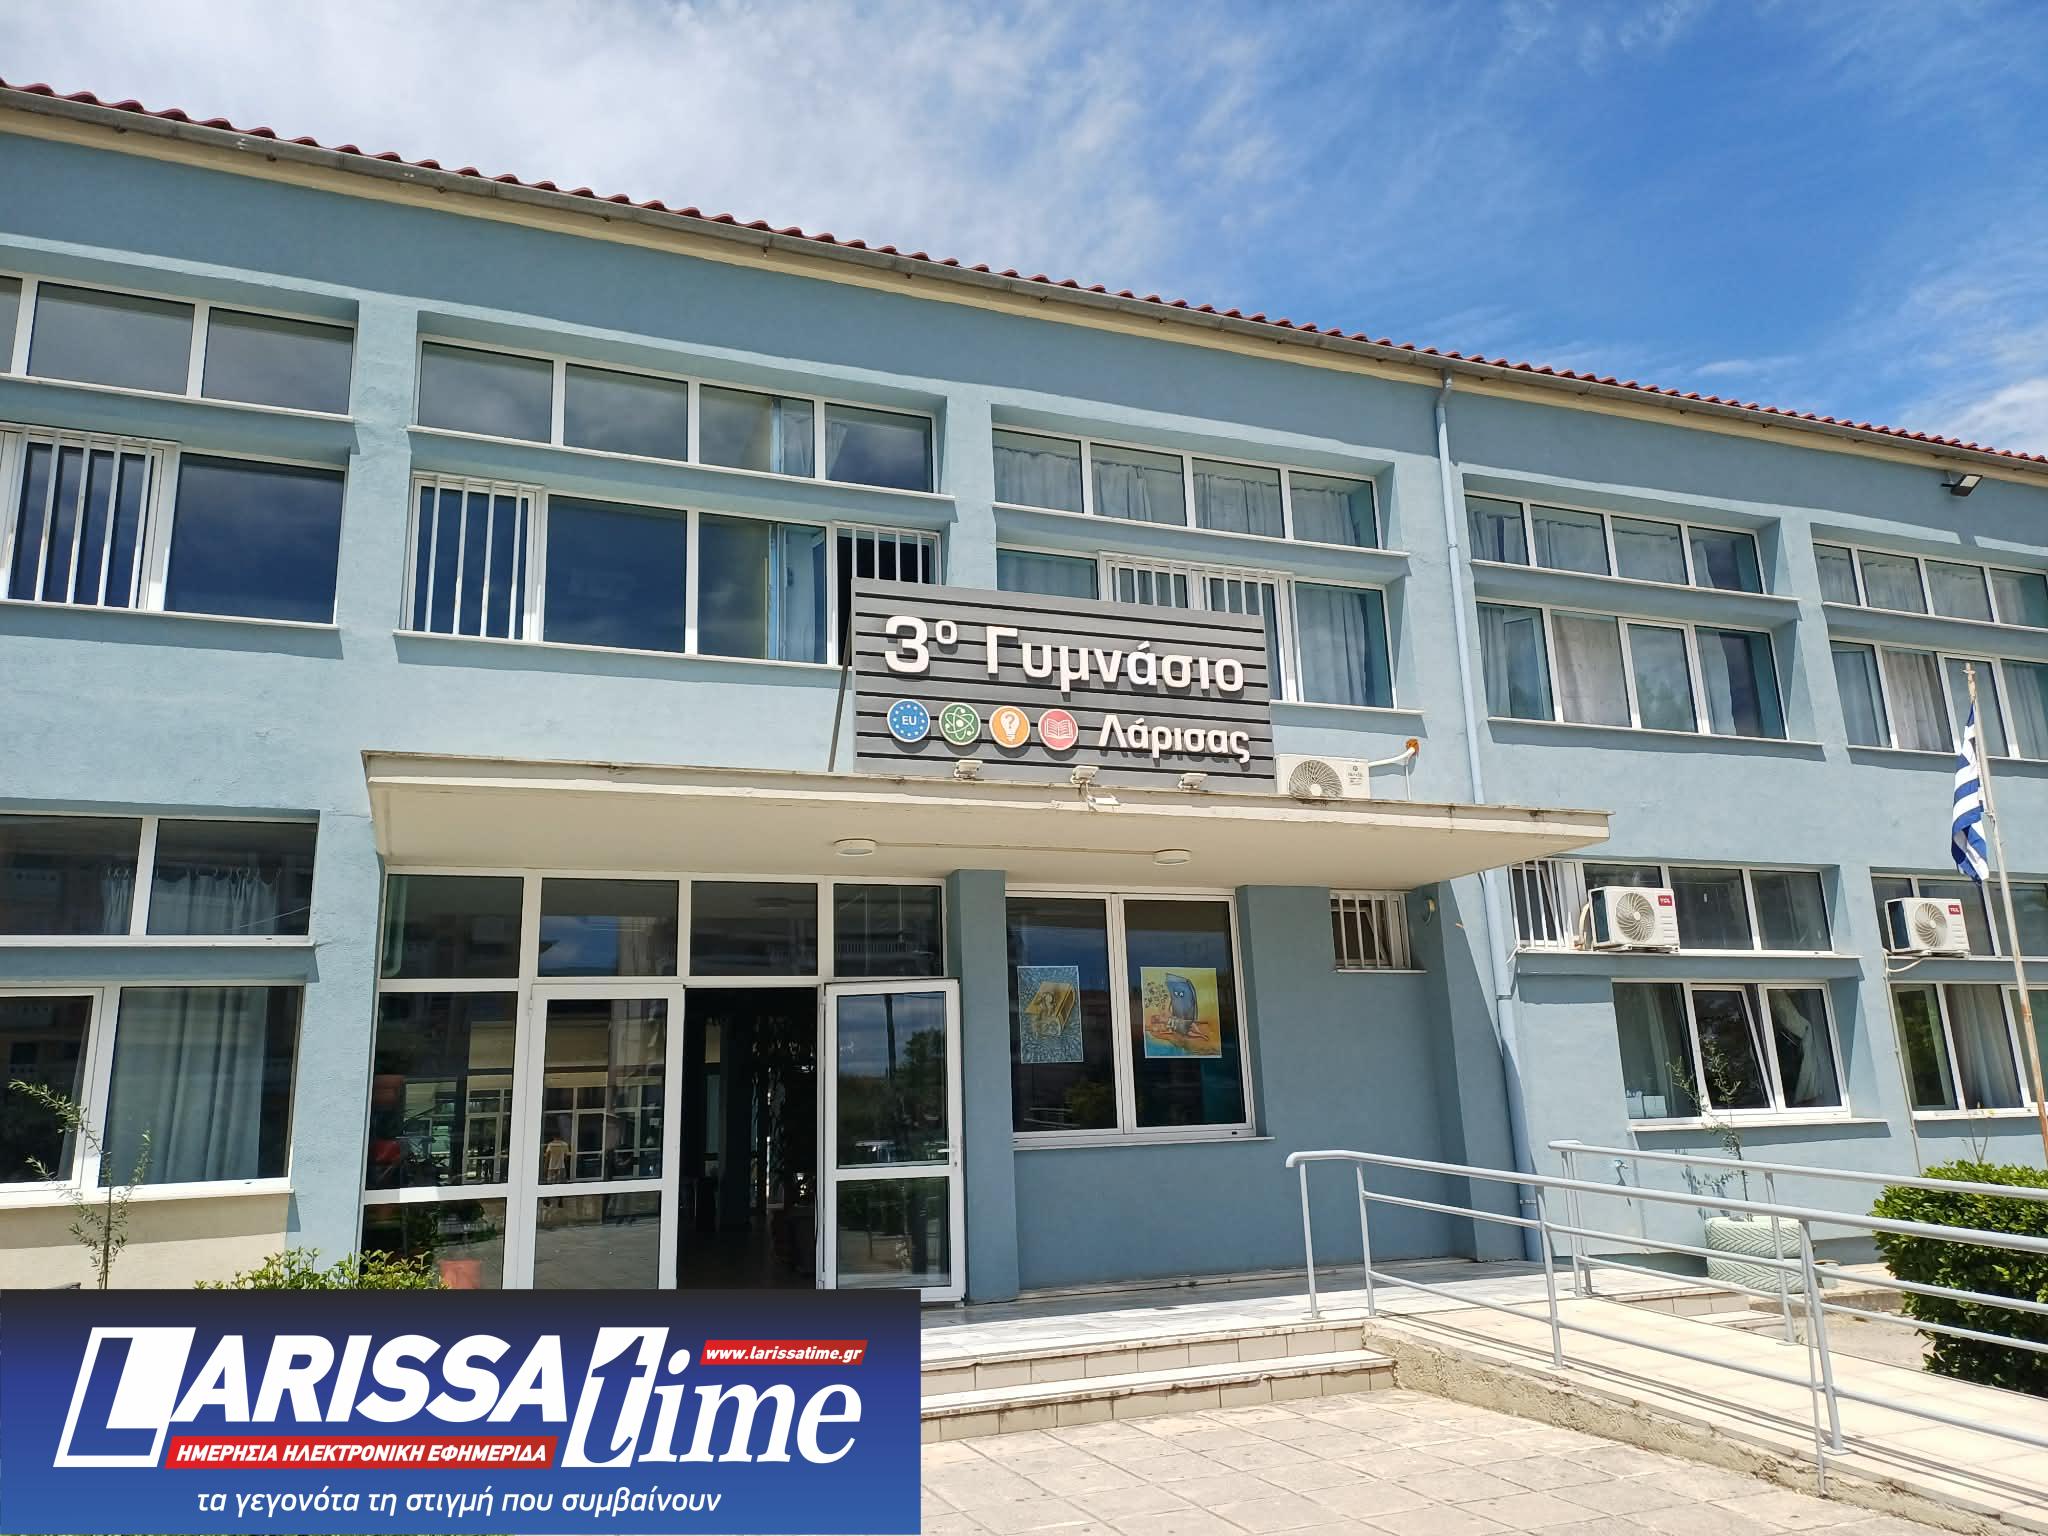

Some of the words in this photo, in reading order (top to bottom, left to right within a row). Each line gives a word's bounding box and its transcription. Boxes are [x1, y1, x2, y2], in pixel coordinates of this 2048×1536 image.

[986, 625, 1245, 693] Γυμνάσιο
[902, 715, 917, 726] EU
[1098, 714, 1250, 763] Λάρισας
